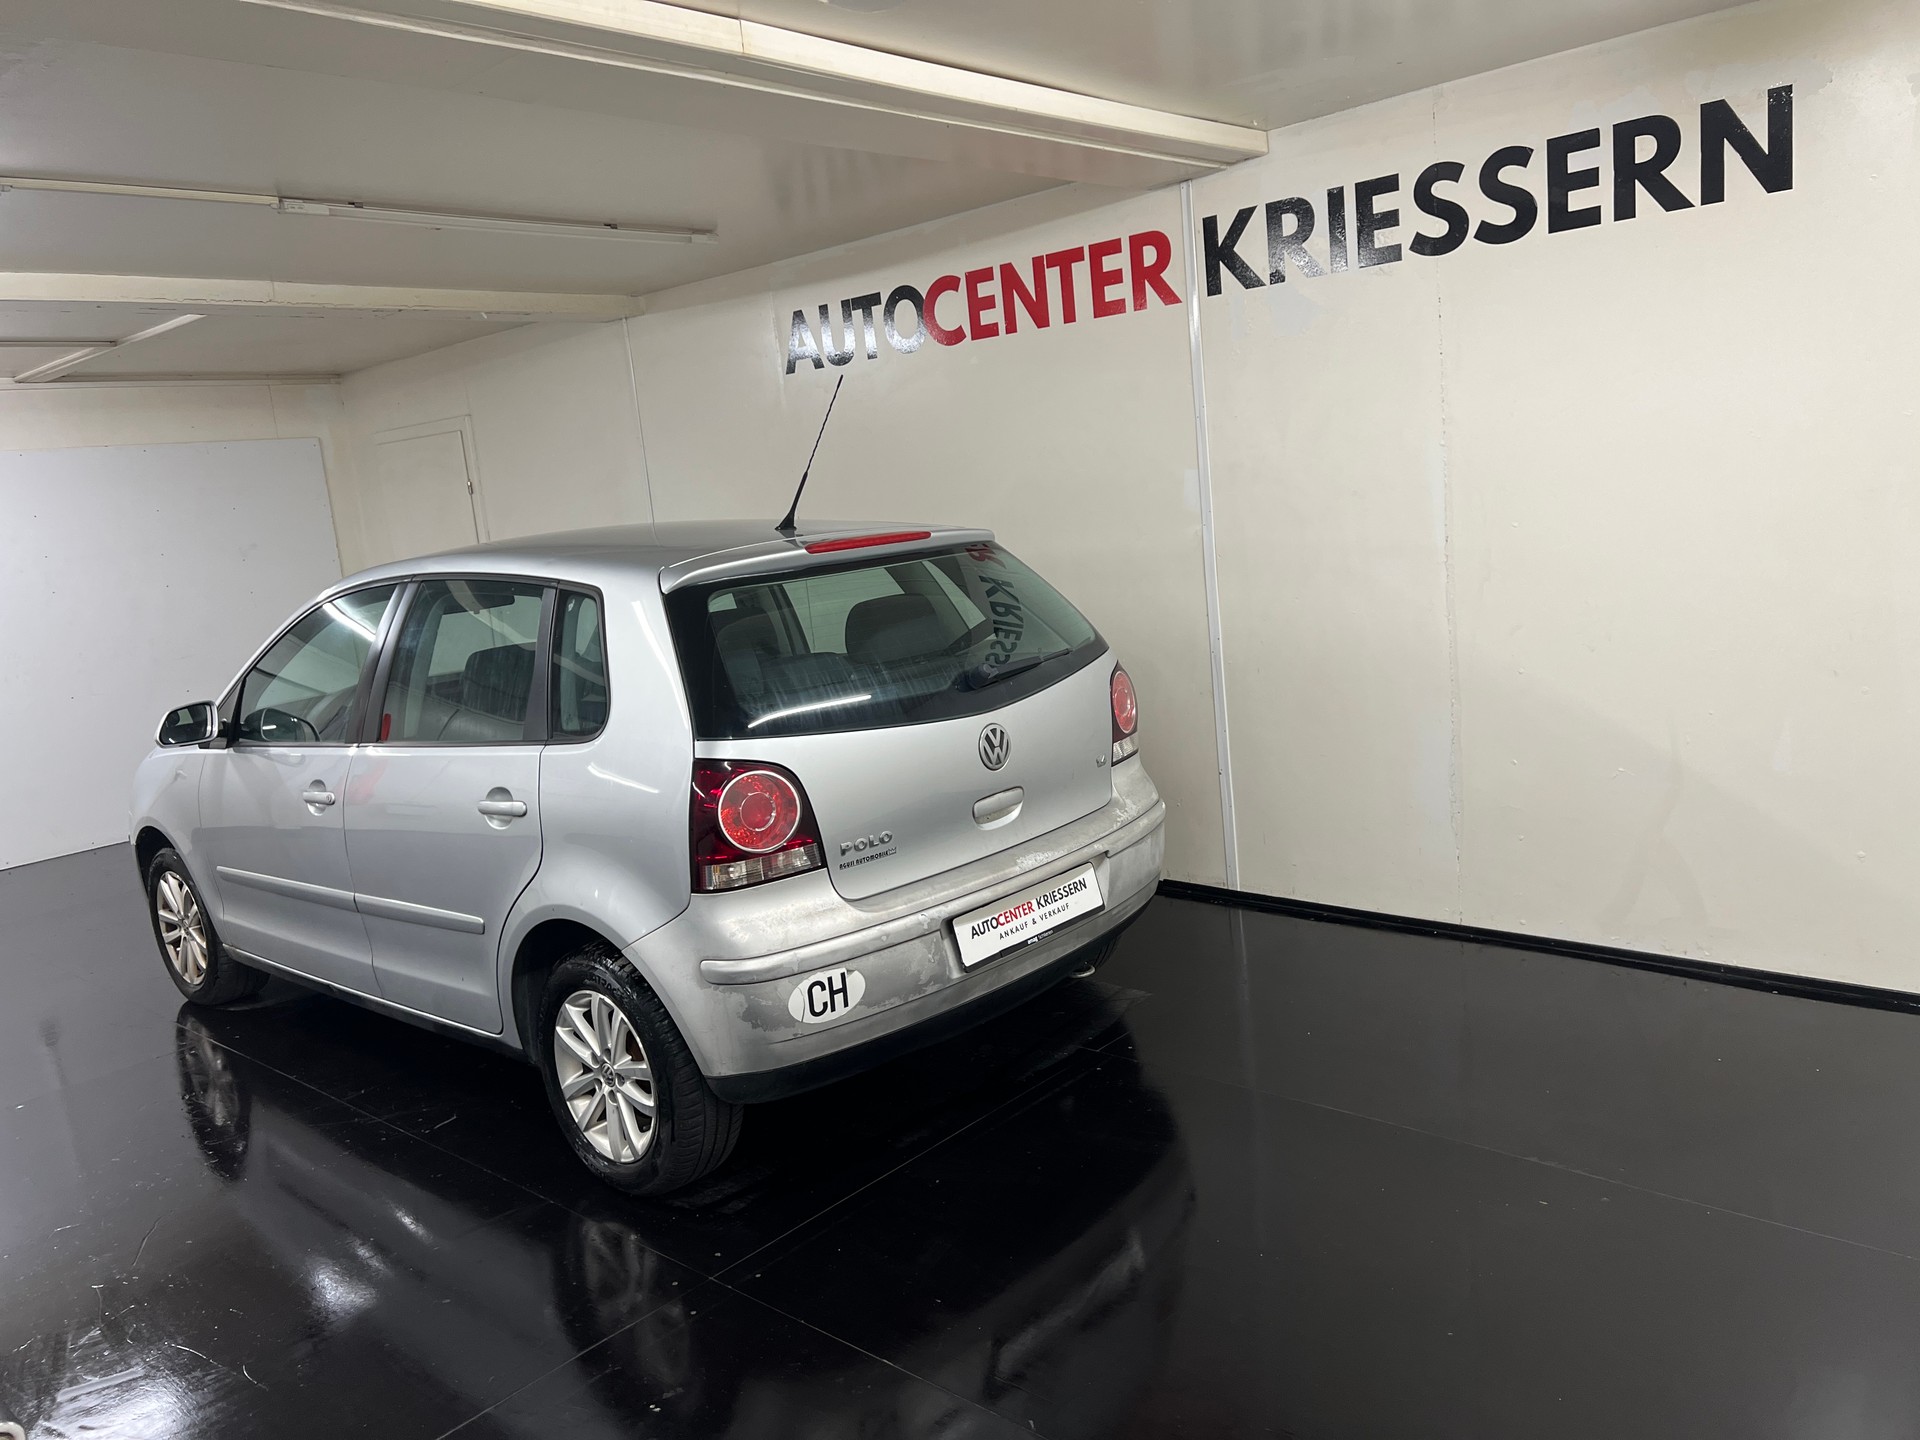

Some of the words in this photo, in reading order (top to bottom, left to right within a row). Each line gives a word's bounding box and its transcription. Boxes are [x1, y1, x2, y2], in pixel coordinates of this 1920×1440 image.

[785, 229, 1183, 375] AUTOCENTER
[1202, 83, 1793, 297] KRIESSERN
[839, 830, 893, 857] POLO
[970, 900, 1036, 940] AUTOCENTER
[1035, 877, 1088, 910] KRIESSERN
[999, 922, 1029, 941] ANKAUF
[1031, 917, 1037, 926] &
[1039, 902, 1070, 921] VERKAUF
[807, 971, 849, 1018] CH
